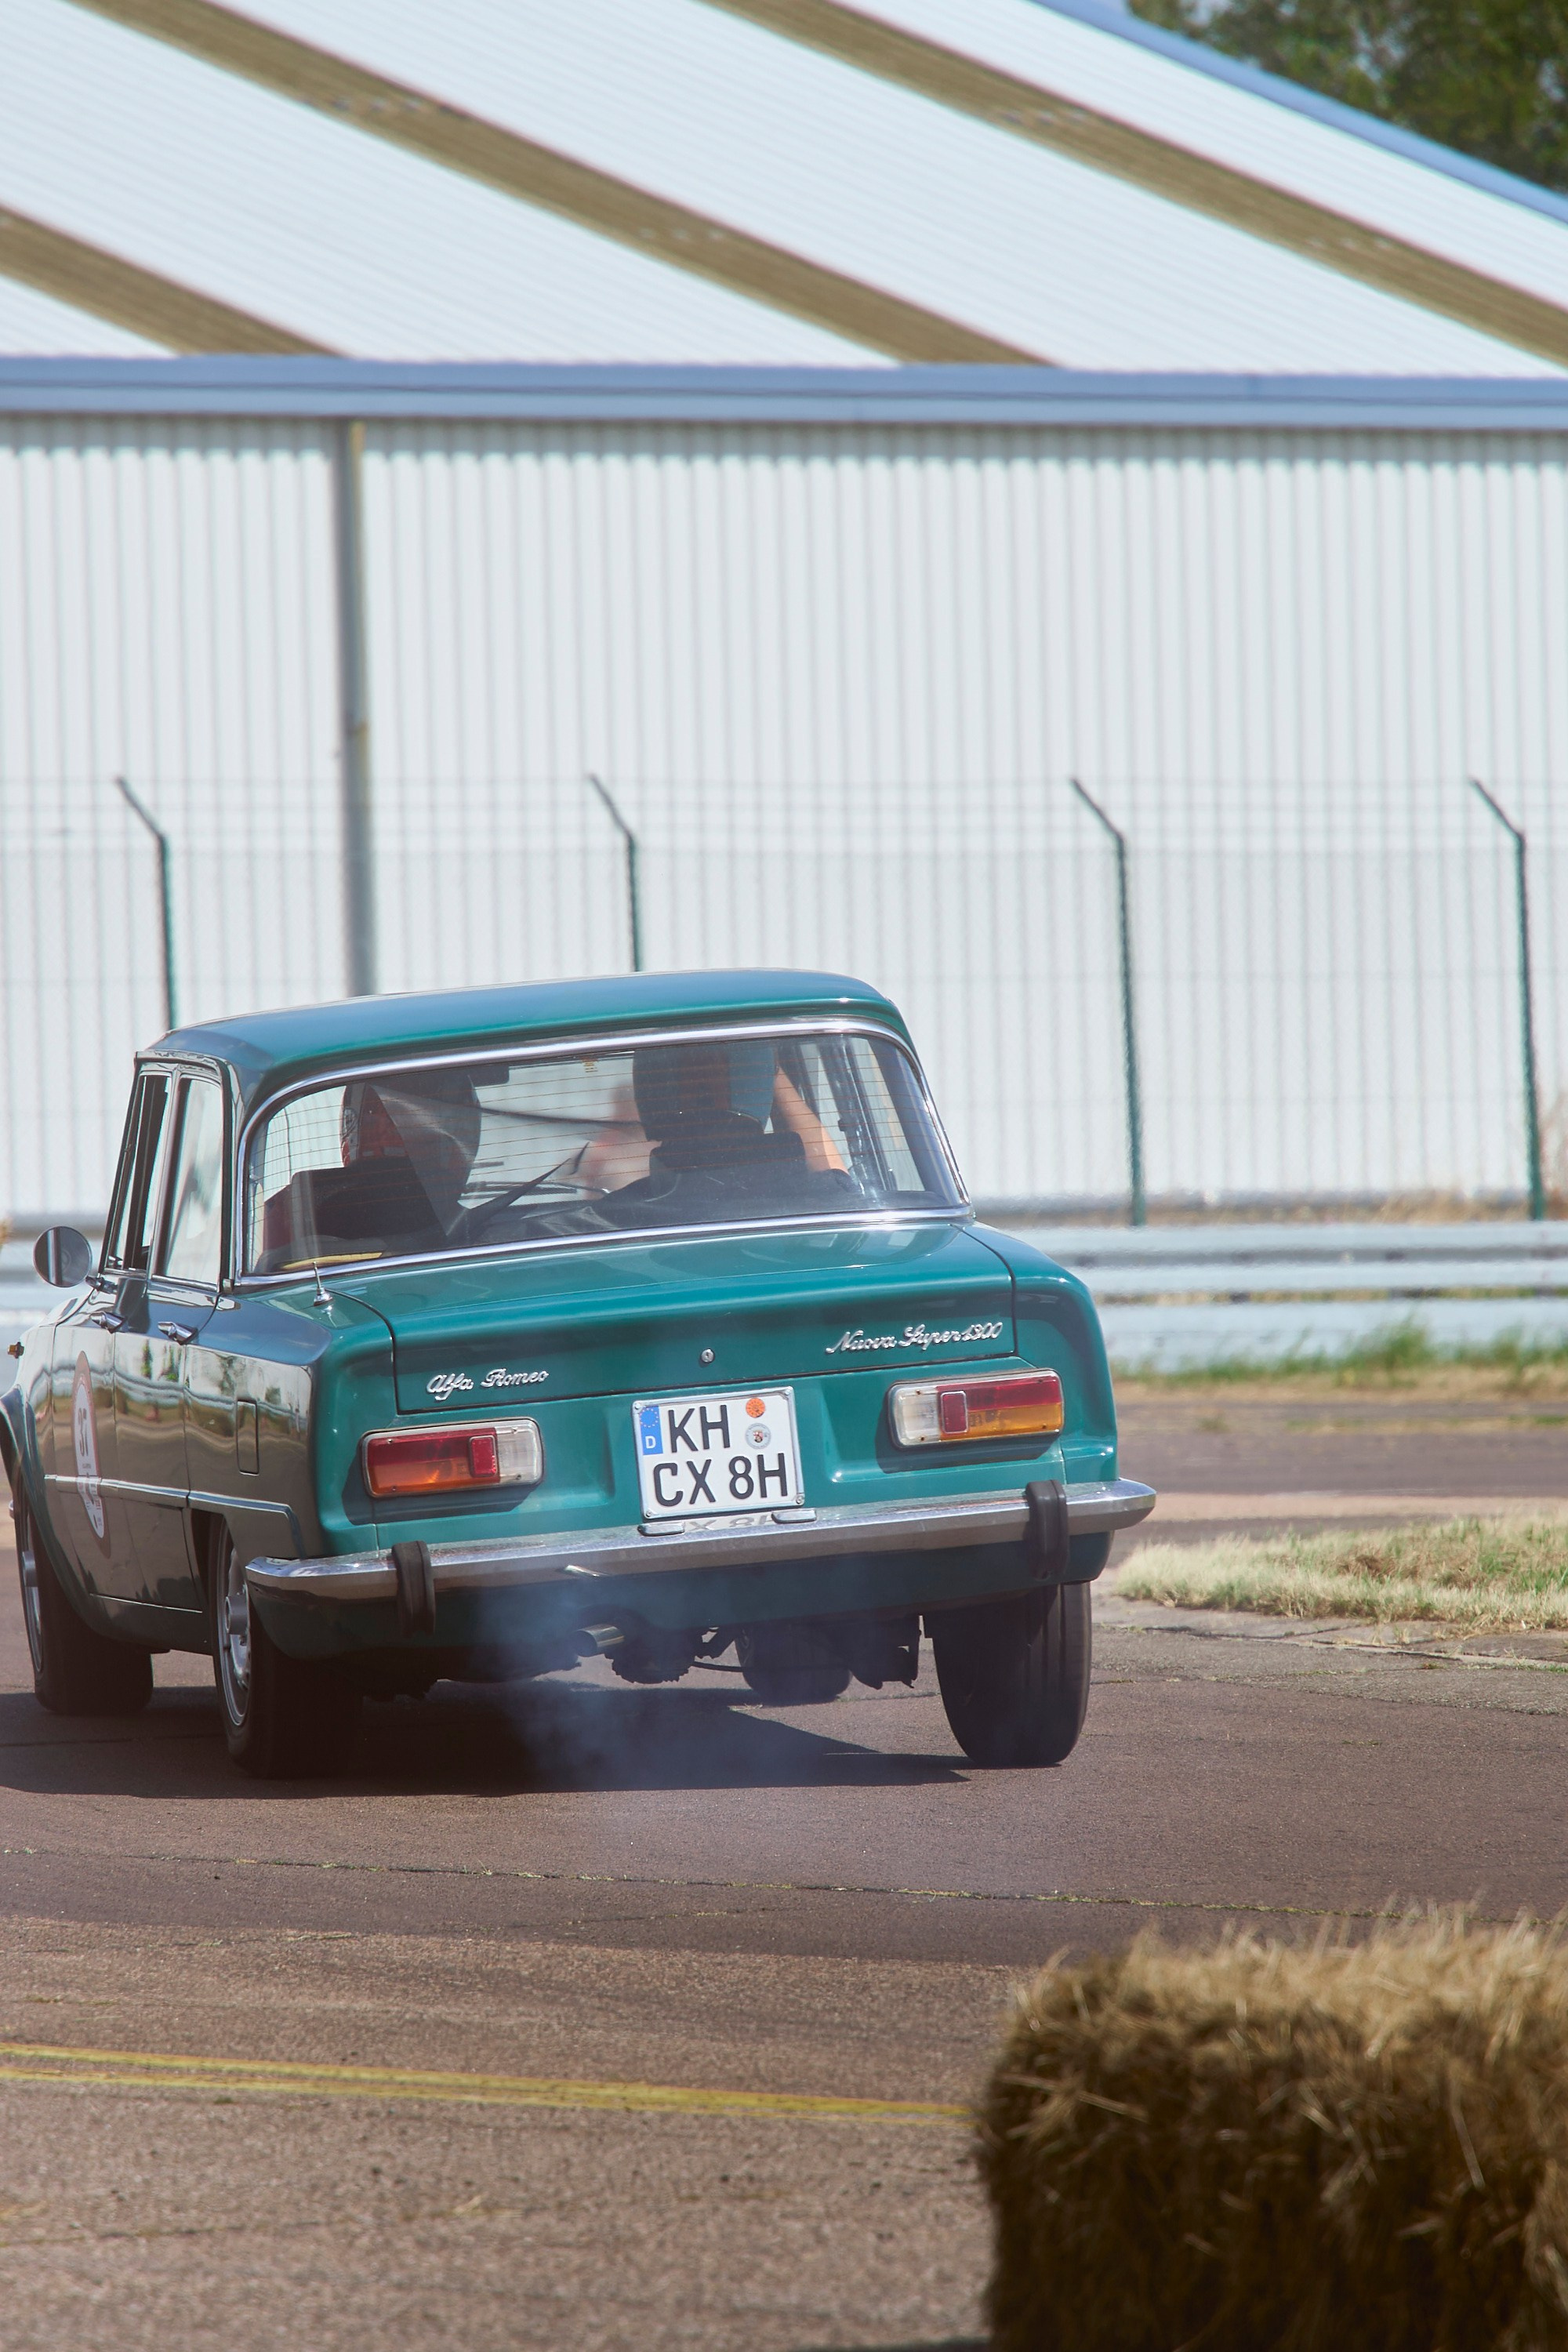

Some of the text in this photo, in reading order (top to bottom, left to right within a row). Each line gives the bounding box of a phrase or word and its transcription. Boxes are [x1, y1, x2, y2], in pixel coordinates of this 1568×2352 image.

[826, 1330, 897, 1353] Nuova
[426, 1368, 549, 1401] Alfa Romeo
[645, 1436, 656, 1449] D
[668, 1404, 730, 1453] KH
[653, 1453, 788, 1507] CX 8H
